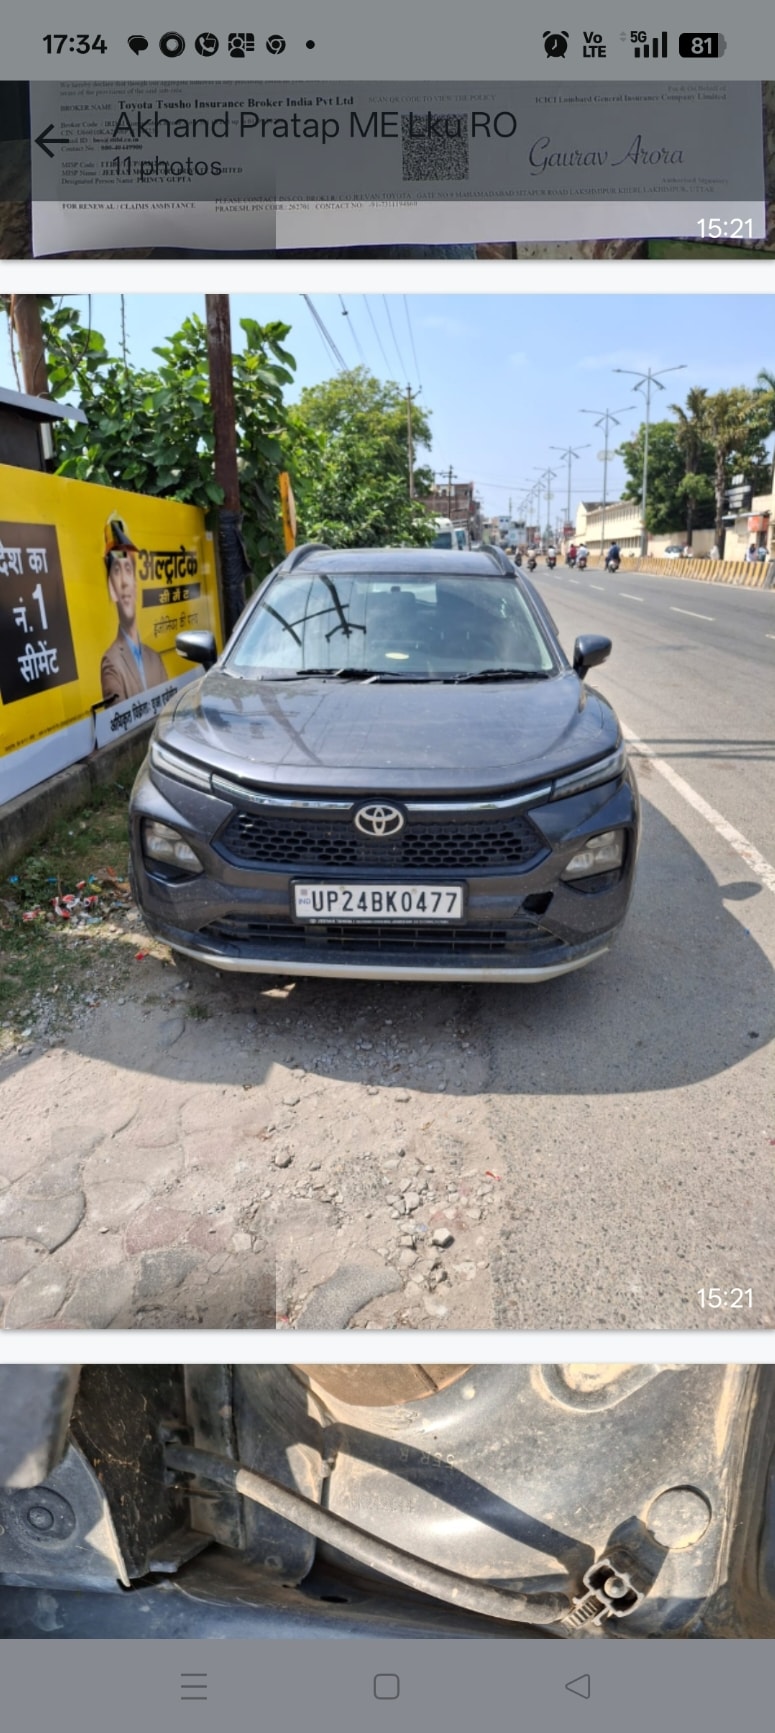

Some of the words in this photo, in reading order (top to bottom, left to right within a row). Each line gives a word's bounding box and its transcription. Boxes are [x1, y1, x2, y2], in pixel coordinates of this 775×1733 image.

[43, 34, 108, 55] 17:34
[583, 31, 603, 44] Vo
[630, 31, 646, 43] 5G
[691, 38, 713, 54] 81
[582, 46, 606, 58] LTE
[118, 99, 153, 112] Toyota
[157, 99, 191, 110] Tsusho
[194, 98, 245, 109] Insurance
[247, 98, 283, 108] Broker
[286, 97, 313, 107] India
[316, 97, 334, 107] Pvt
[336, 96, 354, 106] Ltd
[594, 94, 623, 103] General
[661, 93, 695, 103] Company
[697, 92, 727, 101] Limited
[112, 110, 230, 138] Akhand
[240, 111, 340, 145] Pratap
[350, 111, 399, 138] ME
[409, 110, 462, 138] Lku
[471, 111, 518, 139] RO
[528, 136, 609, 176] Gaurav
[611, 134, 685, 167] Arora
[140, 155, 222, 181] photos
[78, 202, 114, 210] RENEWAL
[150, 201, 196, 209] ASSISTANCE
[26, 547, 49, 574] का
[138, 545, 198, 584] अल्ट्राटेक
[17, 640, 60, 683] सीमेंट
[311, 889, 458, 914] UP24BK0477
